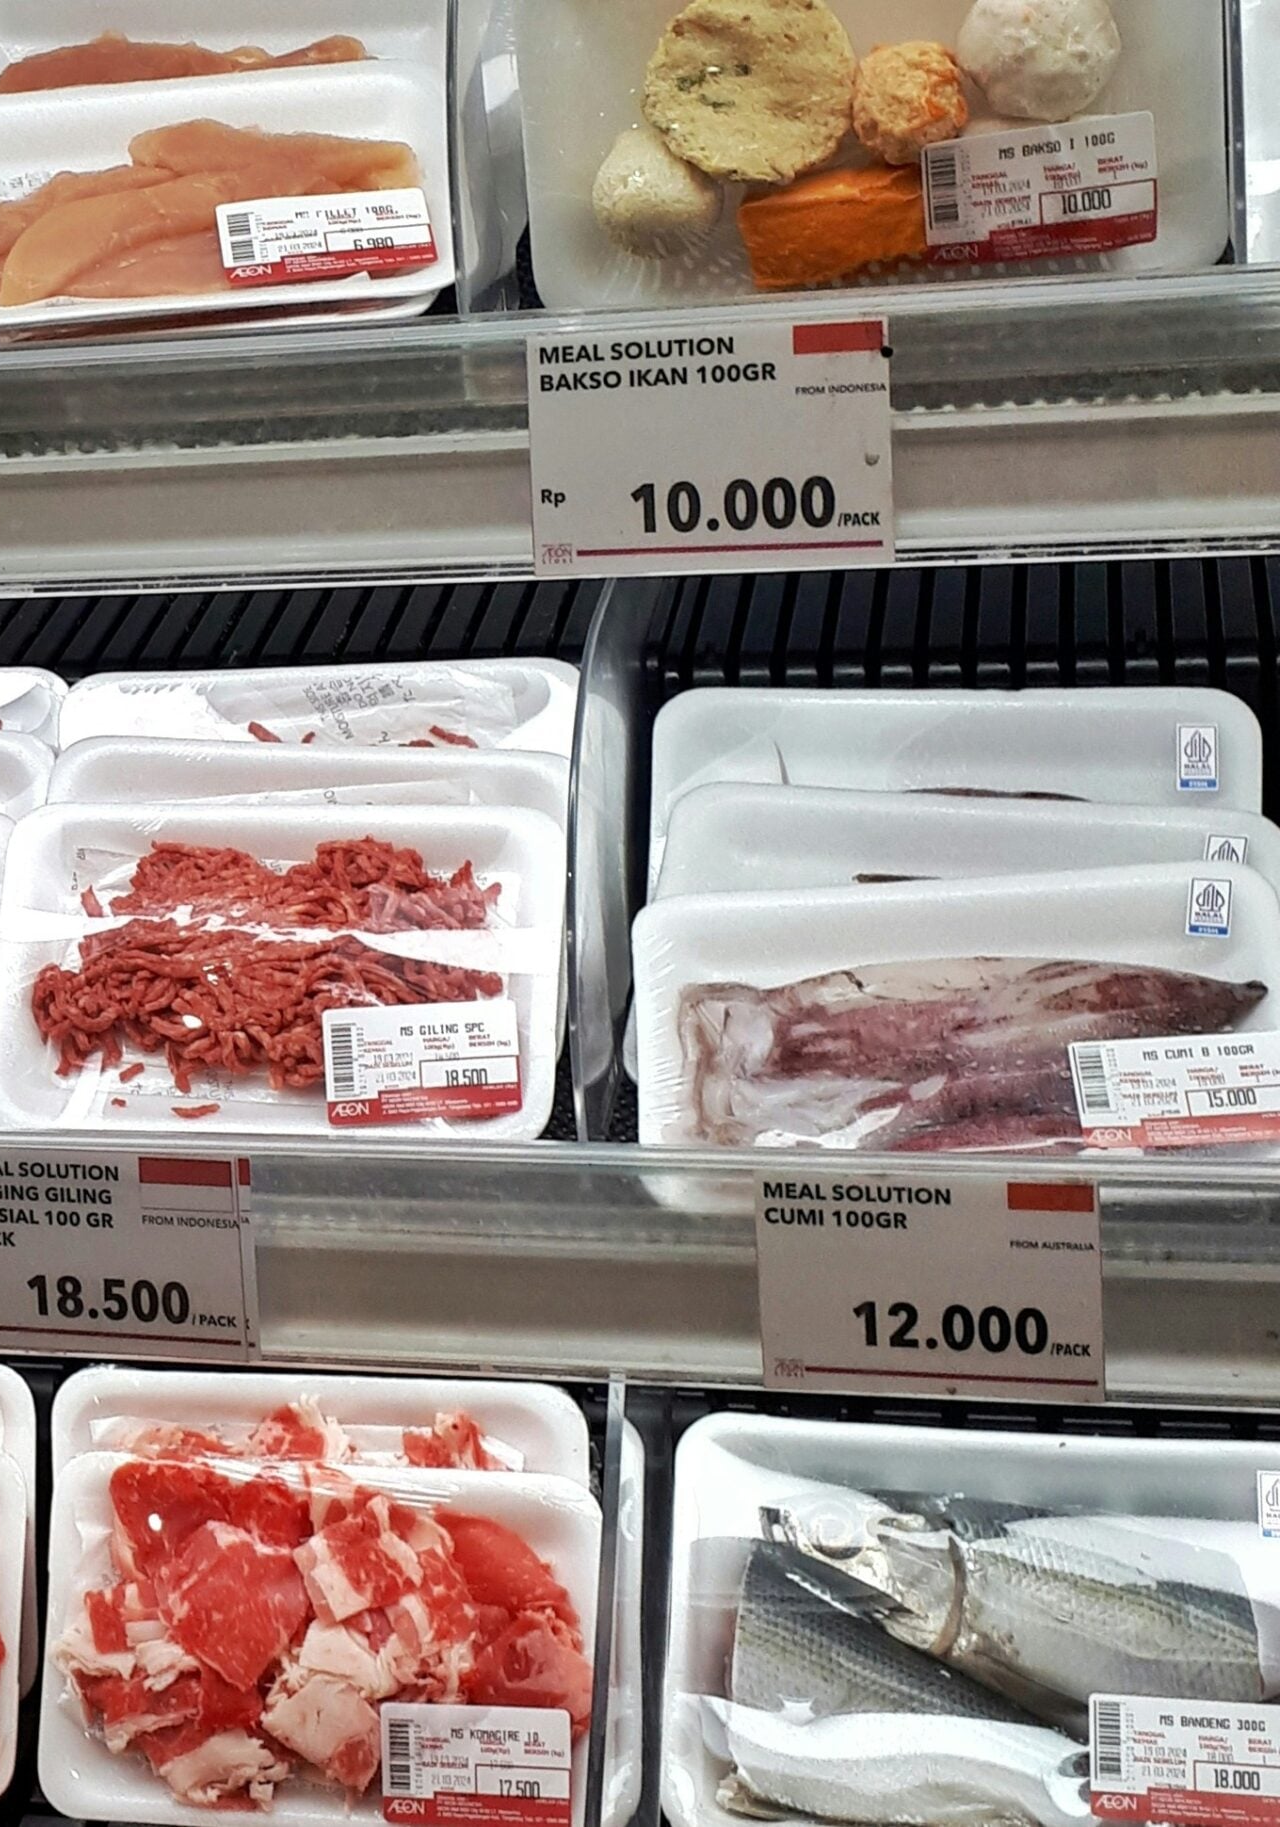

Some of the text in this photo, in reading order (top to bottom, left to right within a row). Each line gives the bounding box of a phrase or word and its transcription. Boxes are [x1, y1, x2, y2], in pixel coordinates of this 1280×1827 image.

[998, 146, 1015, 160] MS
[1022, 140, 1061, 157] BAKSO
[1085, 131, 1115, 148] 100G
[1061, 188, 1112, 215] 10.000
[353, 236, 394, 251] 6980
[539, 336, 734, 364] MEAL SOLUTION
[540, 362, 776, 392] BAKSO IKAN 100GR
[795, 382, 887, 396] FROM INDONESIA
[540, 475, 880, 534] Rp 10.000 /PACK
[400, 1022, 485, 1036] MS GILING SPC
[1142, 1050, 1159, 1061] MS
[1164, 1047, 1194, 1059] CUMI
[1217, 1044, 1255, 1056] 100GR
[445, 1068, 488, 1087] 18500
[1207, 1088, 1257, 1109] 15.000
[18, 1162, 119, 1181] SOLUTION
[45, 1186, 112, 1205] GILING
[763, 1180, 952, 1206] MEAL SOLUTION
[44, 1210, 81, 1227] 100
[86, 1211, 114, 1229] GR
[141, 1214, 174, 1226] FROM
[176, 1216, 240, 1230] INDONESIA
[764, 1207, 908, 1230] CUMI 100GR
[1009, 1239, 1095, 1251] FROM AUSTRALIA
[27, 1274, 190, 1325] 18.500
[852, 1300, 1091, 1357] 12.000 /PACK
[1159, 1714, 1266, 1732] MS BANDENG 300G
[450, 1728, 464, 1740] MS
[499, 1778, 541, 1799] 17500
[1214, 1768, 1261, 1791] 18.000
